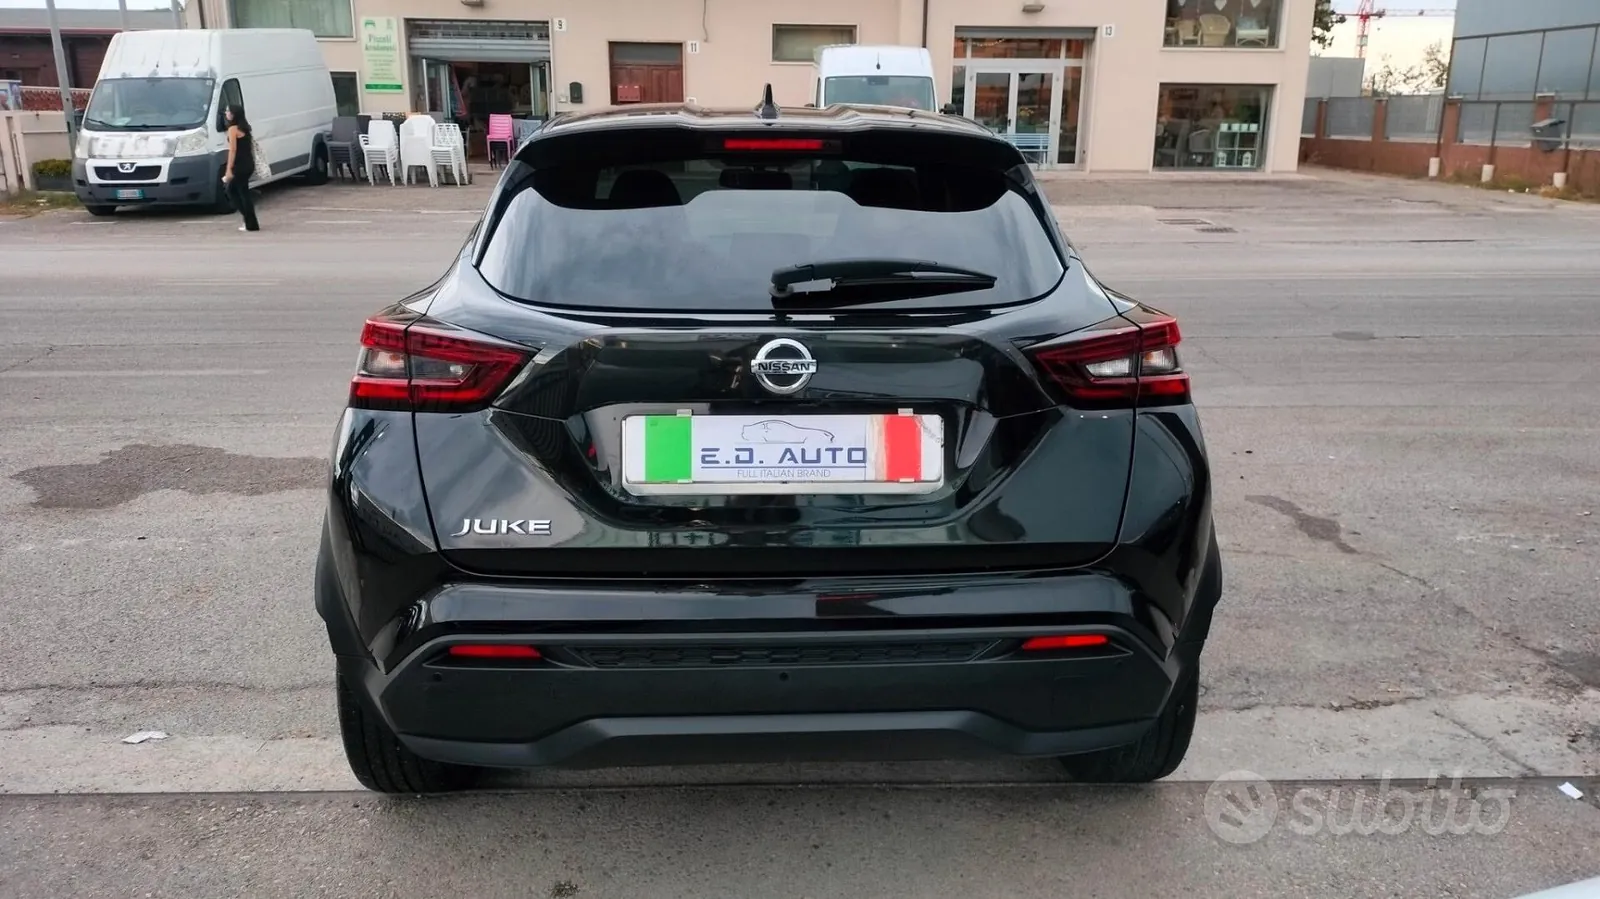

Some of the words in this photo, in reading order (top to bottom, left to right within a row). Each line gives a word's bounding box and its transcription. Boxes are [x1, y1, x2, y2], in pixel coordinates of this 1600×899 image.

[557, 19, 563, 29] 9
[1105, 26, 1113, 36] 13
[690, 43, 697, 52] 11
[757, 363, 810, 371] NISSAN
[701, 447, 764, 464] E.D.
[778, 447, 867, 464] AUTO
[737, 469, 758, 478] FULL
[760, 469, 795, 478] ITALIAN
[797, 469, 831, 478] BRAND
[450, 518, 552, 537] JUKE
